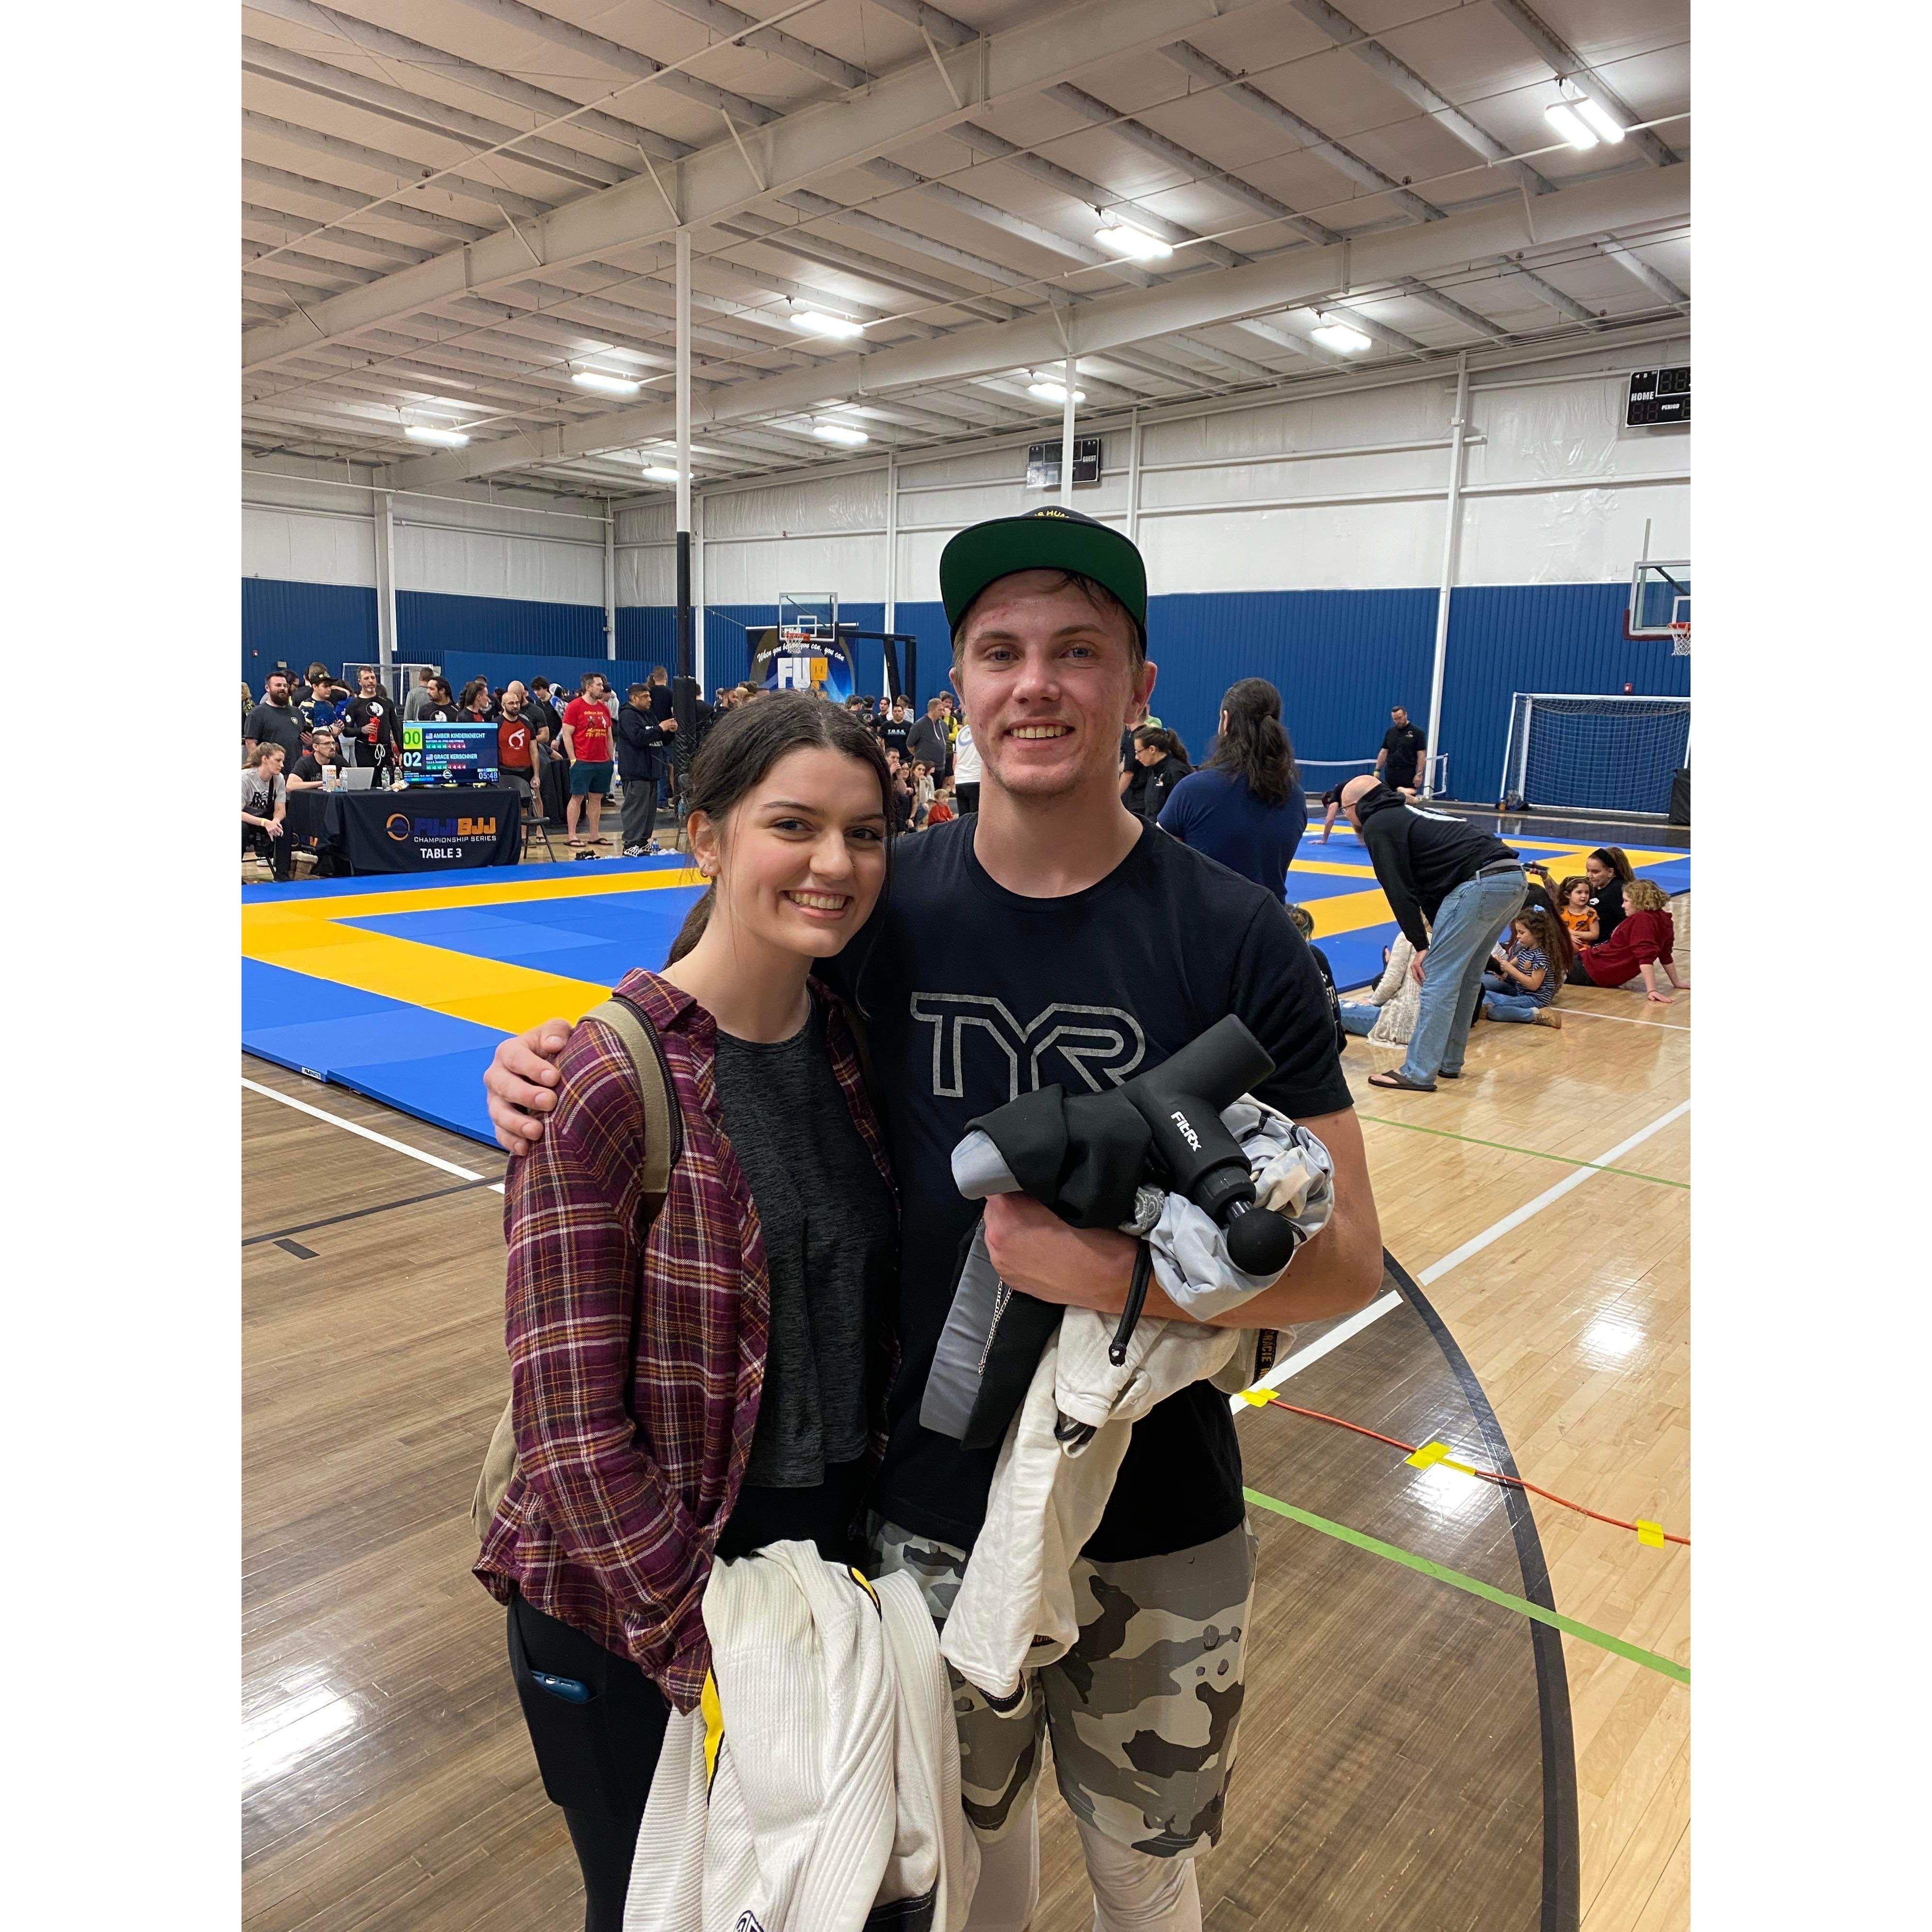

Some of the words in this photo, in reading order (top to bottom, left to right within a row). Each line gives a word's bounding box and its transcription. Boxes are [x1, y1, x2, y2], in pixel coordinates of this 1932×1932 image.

[1631, 391, 1655, 401] HOME
[757, 649, 772, 663] When
[772, 646, 782, 656] you
[824, 647, 834, 656] you
[834, 652, 845, 661] can
[403, 731, 421, 745] 00
[403, 752, 422, 767] 02
[479, 772, 498, 780] 05:48
[420, 848, 453, 859] TABLE
[456, 848, 462, 858] 3
[910, 992, 1145, 1102] TYR
